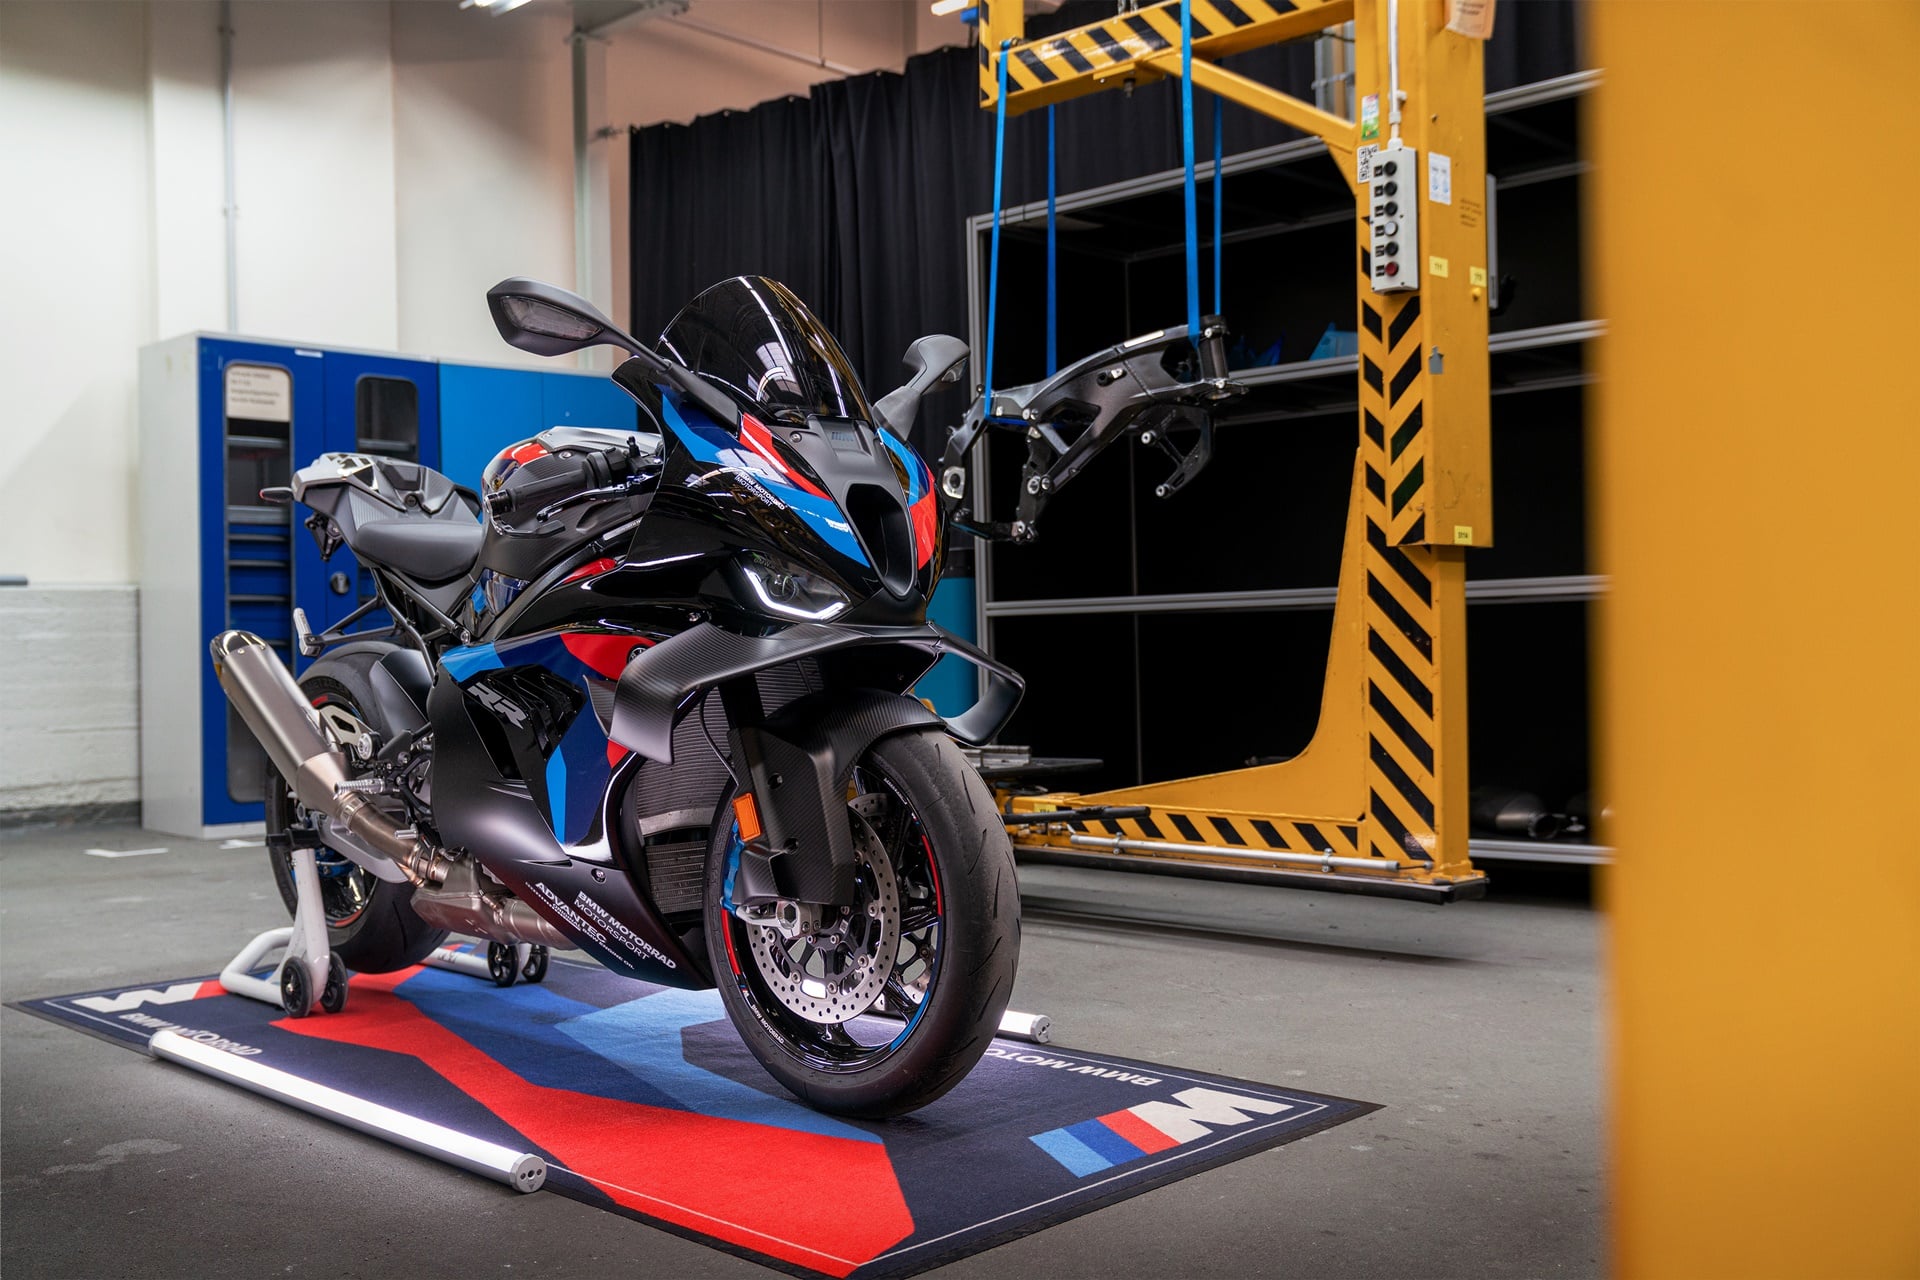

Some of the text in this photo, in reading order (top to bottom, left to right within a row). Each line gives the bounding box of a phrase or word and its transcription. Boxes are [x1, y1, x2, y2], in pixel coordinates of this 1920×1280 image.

[736, 476, 773, 507] MOTORSPORT
[467, 682, 527, 729] RR
[535, 882, 607, 944] ADVANTEC
[552, 903, 581, 931] ORIGINAL
[582, 927, 602, 944] BMW
[599, 941, 623, 962] ENGINE
[574, 899, 650, 960] MOTORSPORT
[577, 890, 678, 970] BMW MOTORRAD
[118, 1012, 174, 1031] BMW
[751, 1004, 785, 1044] BMW MOTORRAD
[1068, 1066, 1163, 1086] BMW
[1127, 1086, 1294, 1145] M
